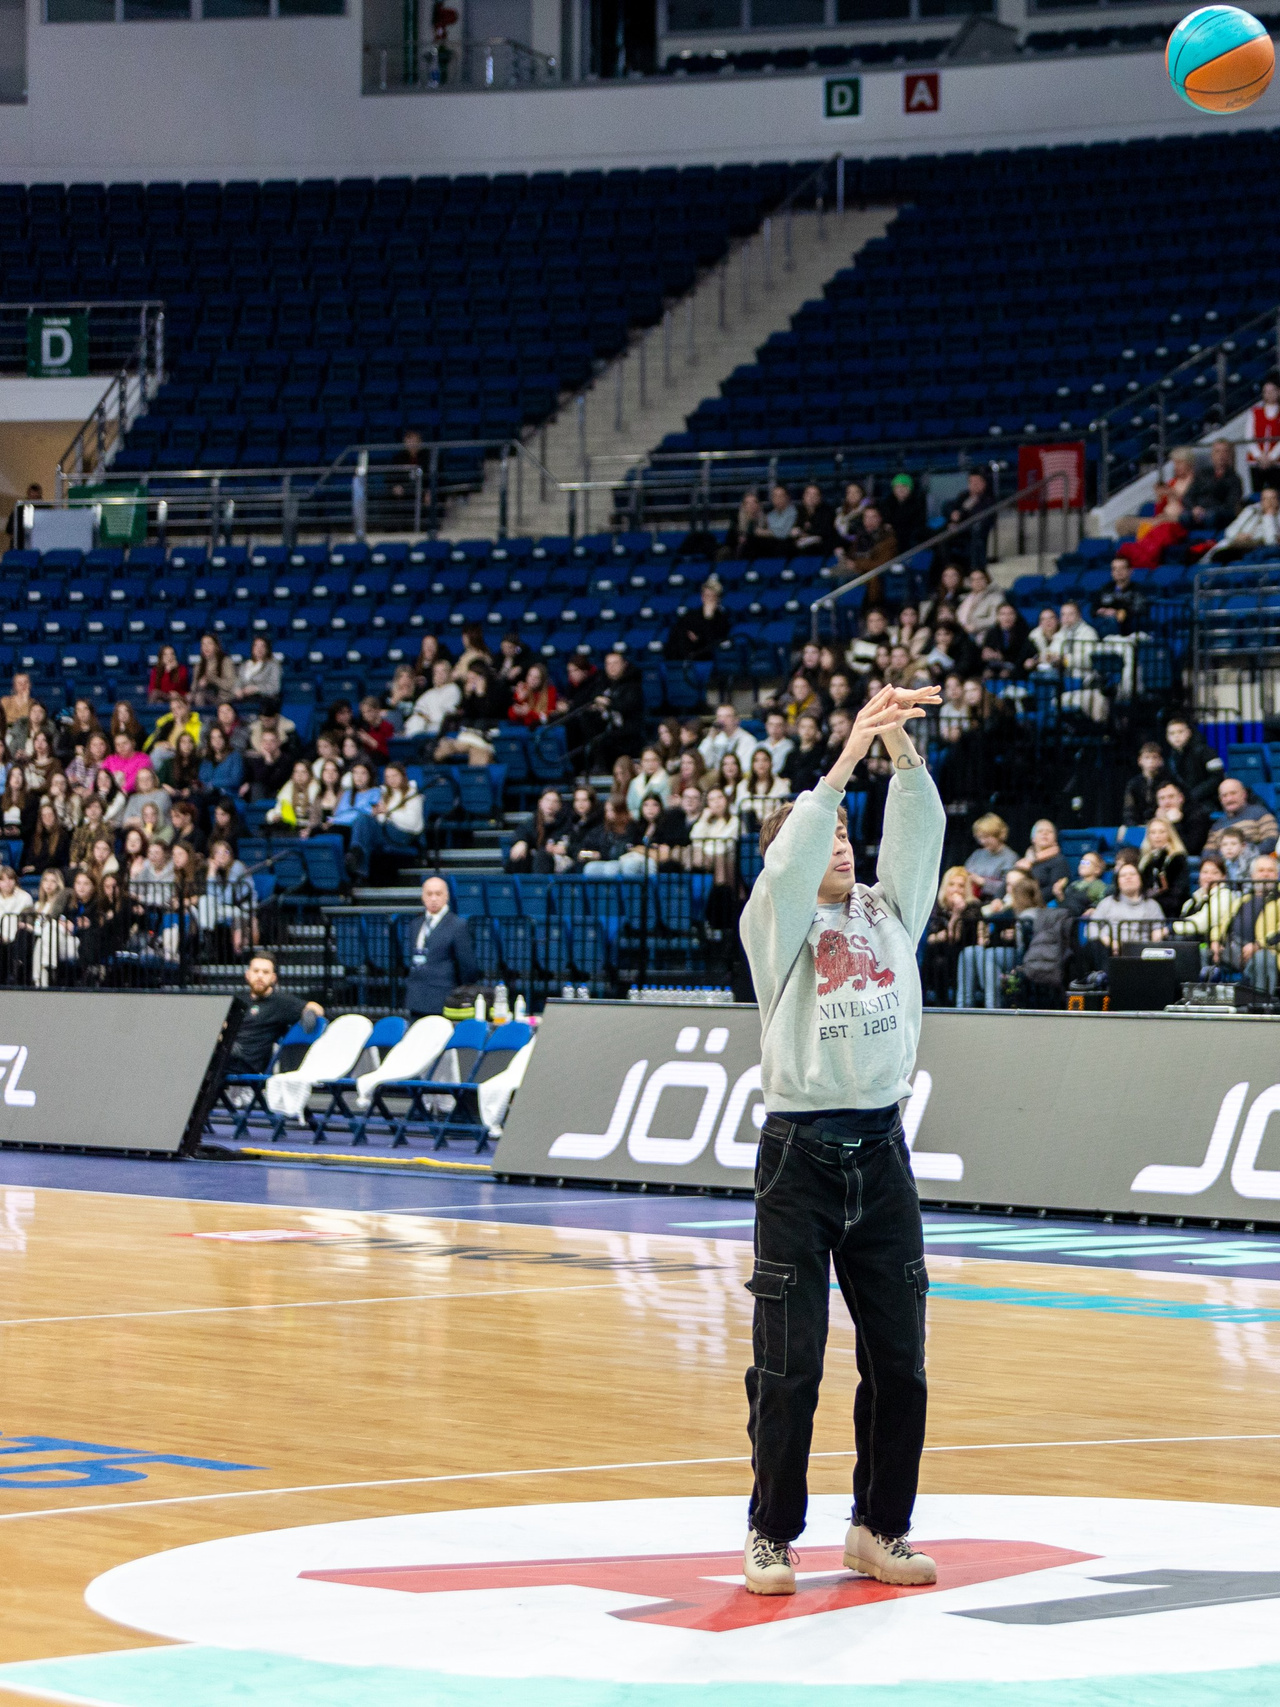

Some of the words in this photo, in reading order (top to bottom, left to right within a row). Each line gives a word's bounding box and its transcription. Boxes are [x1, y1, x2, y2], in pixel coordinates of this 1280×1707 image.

[830, 83, 855, 114] D
[908, 78, 935, 109] A
[40, 327, 73, 368] D
[817, 989, 902, 1021] NIVERSITY
[819, 1023, 855, 1041] EST.
[863, 1015, 898, 1037] 1209
[548, 1026, 964, 1181] JÖL
